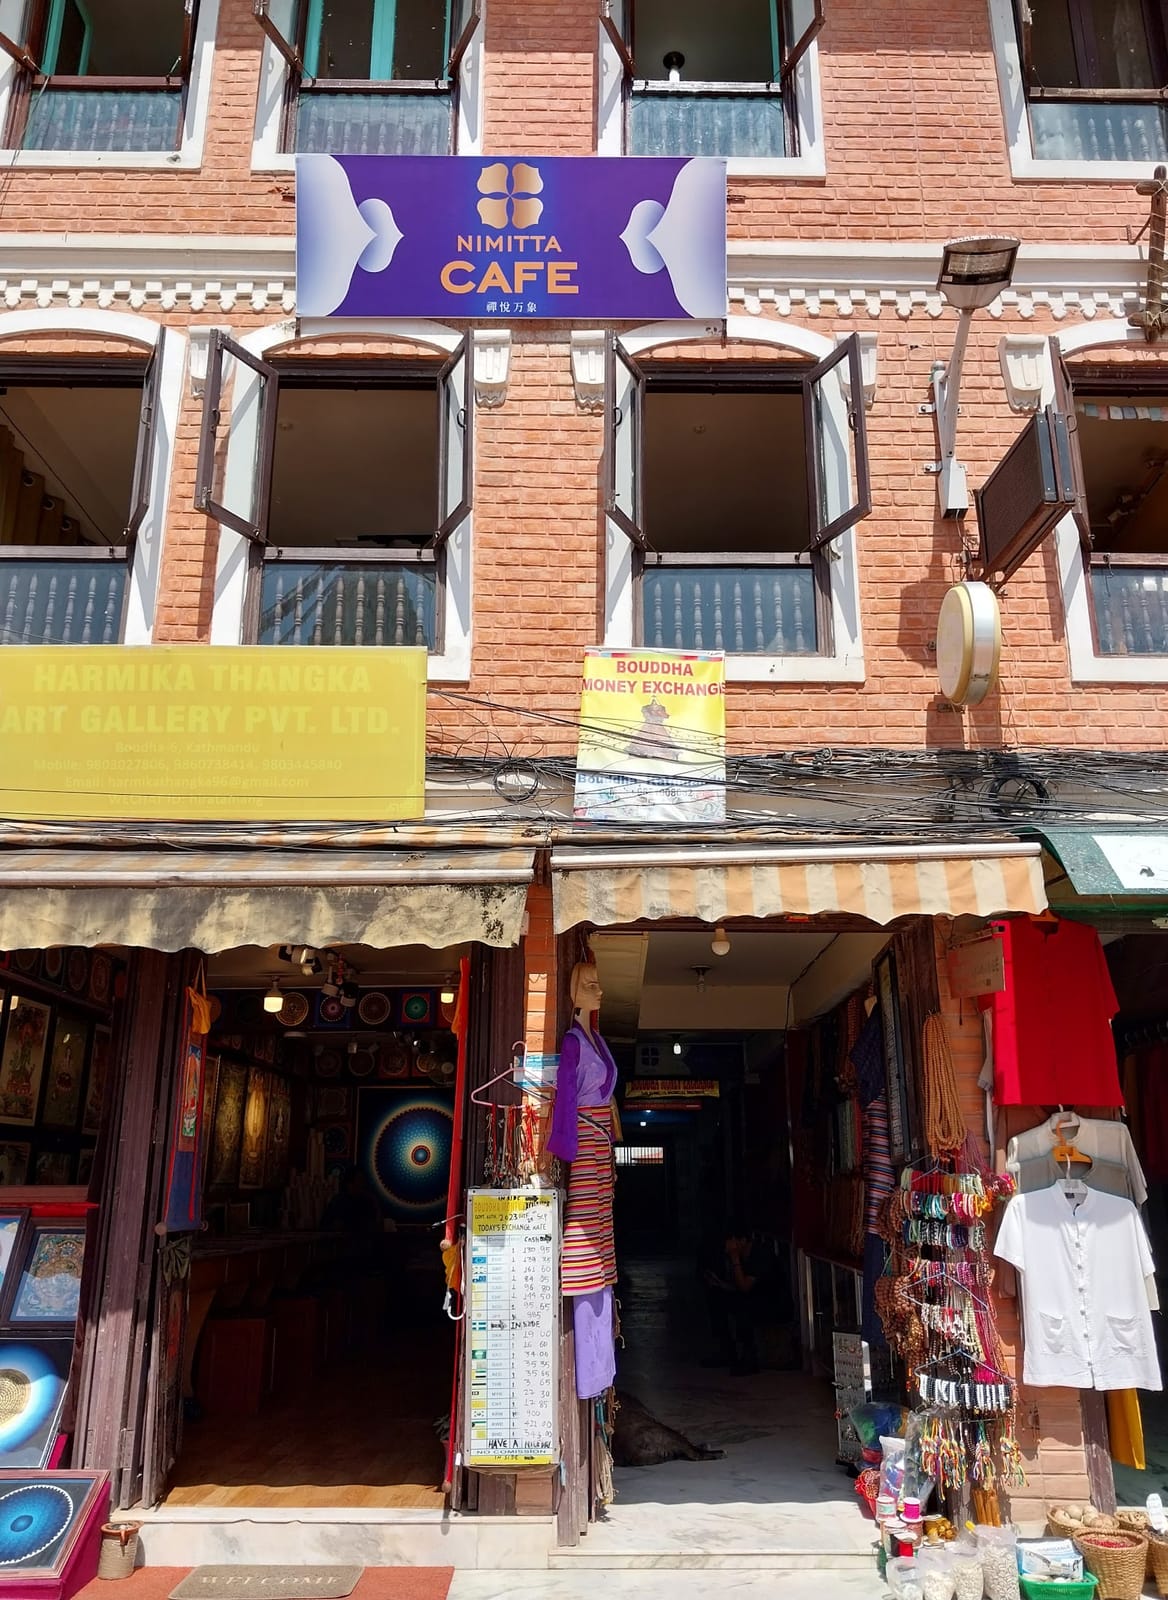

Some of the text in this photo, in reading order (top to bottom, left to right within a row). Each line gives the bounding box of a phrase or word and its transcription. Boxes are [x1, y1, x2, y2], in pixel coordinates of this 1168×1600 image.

[457, 235, 562, 252] NIMITTA
[440, 260, 579, 294] CAFE
[616, 661, 694, 676] BOUDDHA
[33, 664, 370, 693] HARMIKA THANGKA
[582, 679, 637, 693] MONEY
[0, 705, 401, 734] ART GALLERY PVT. LTD.
[489, 1438, 508, 1449] HAVE
[201, 1576, 343, 1585] WELCOME
